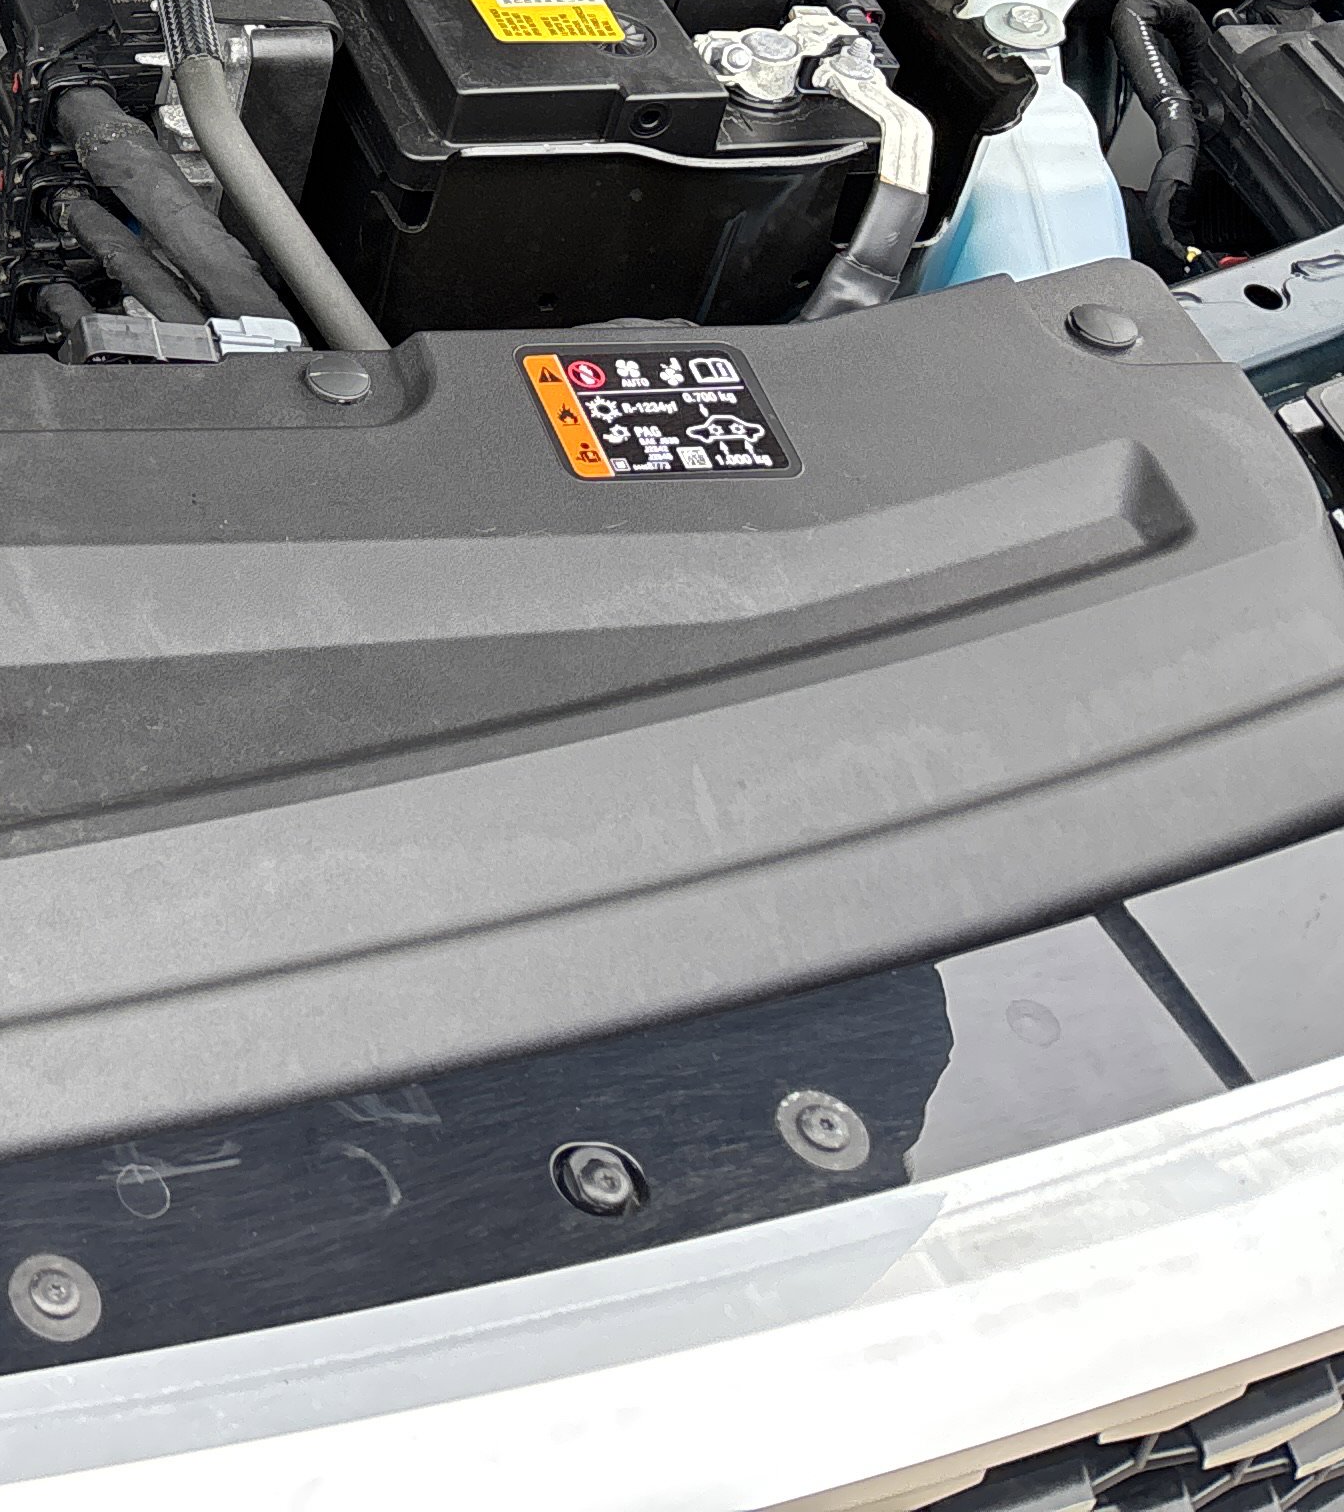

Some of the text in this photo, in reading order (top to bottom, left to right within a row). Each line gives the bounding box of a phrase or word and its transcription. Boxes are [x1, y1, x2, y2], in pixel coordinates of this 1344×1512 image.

[621, 377, 650, 388] AUTO
[681, 391, 738, 404] 0.700 kg
[633, 425, 663, 438] PAG
[715, 453, 753, 467] 1.000
